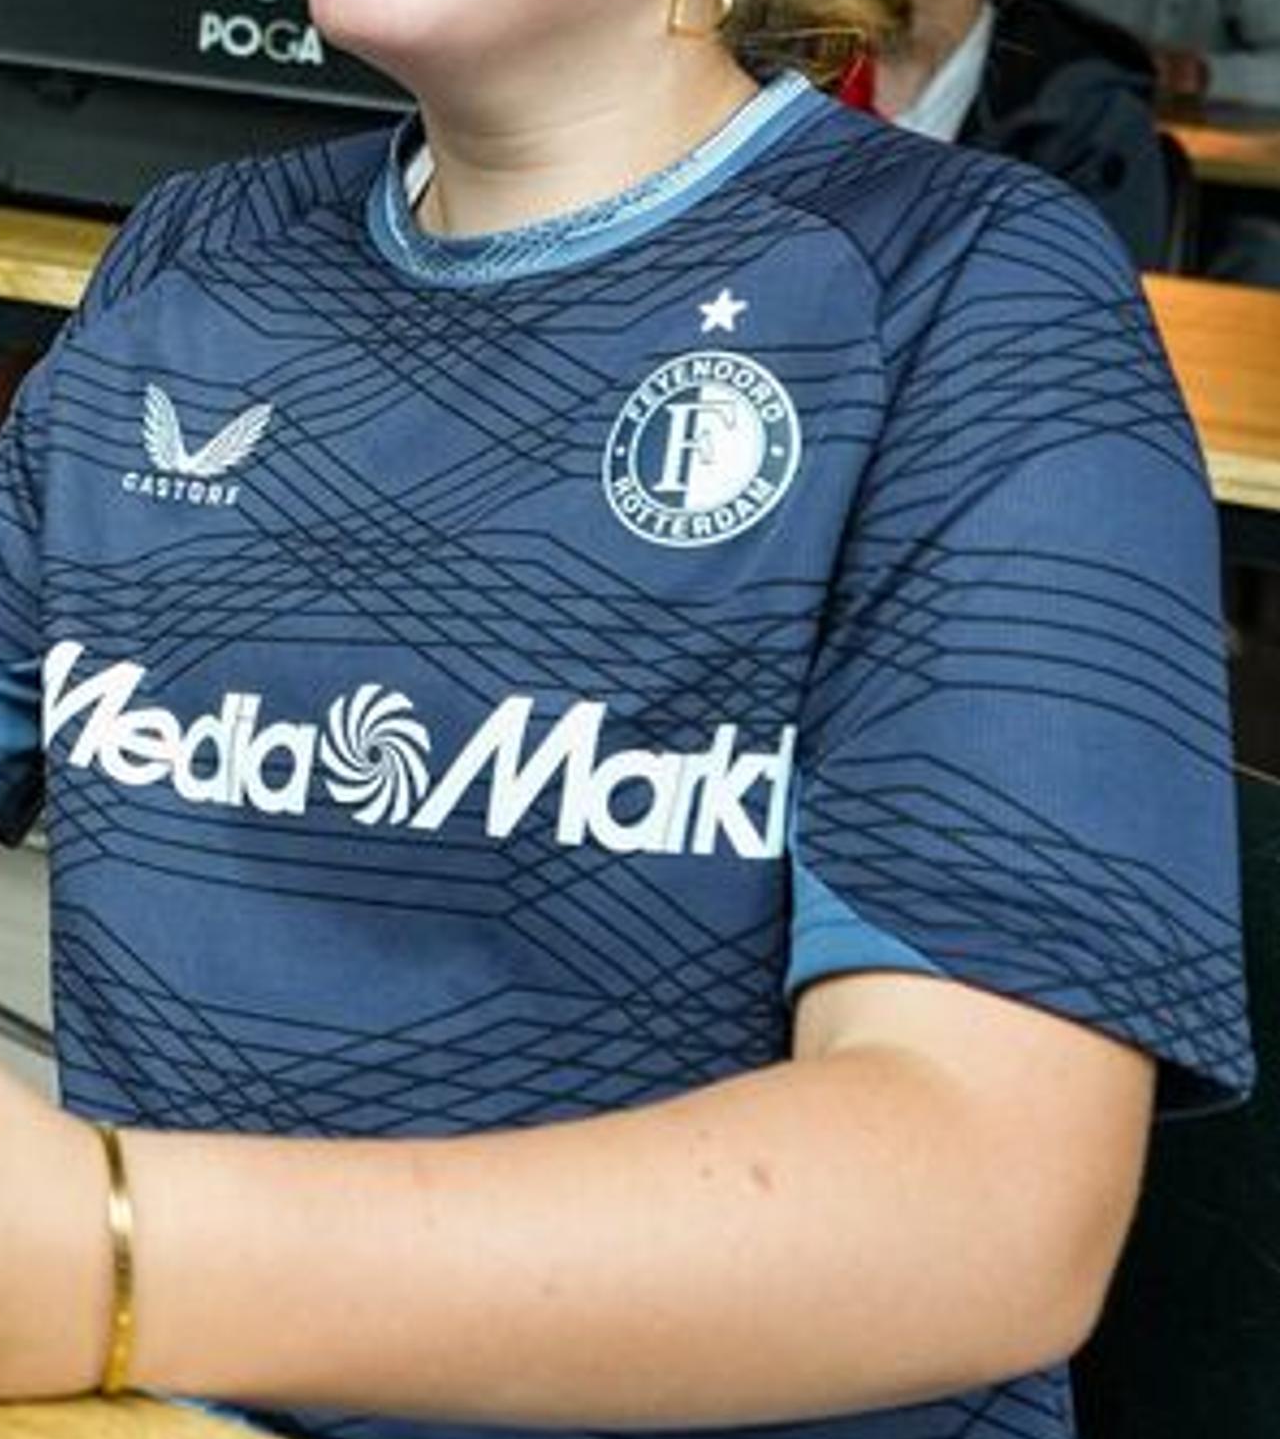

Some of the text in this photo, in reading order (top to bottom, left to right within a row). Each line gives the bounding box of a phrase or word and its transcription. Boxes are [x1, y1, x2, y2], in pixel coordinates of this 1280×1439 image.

[199, 12, 324, 64] POGA
[626, 357, 786, 424] FEYENOORD
[121, 471, 241, 507] CASTORE
[611, 474, 777, 540] ROTTERDAM
